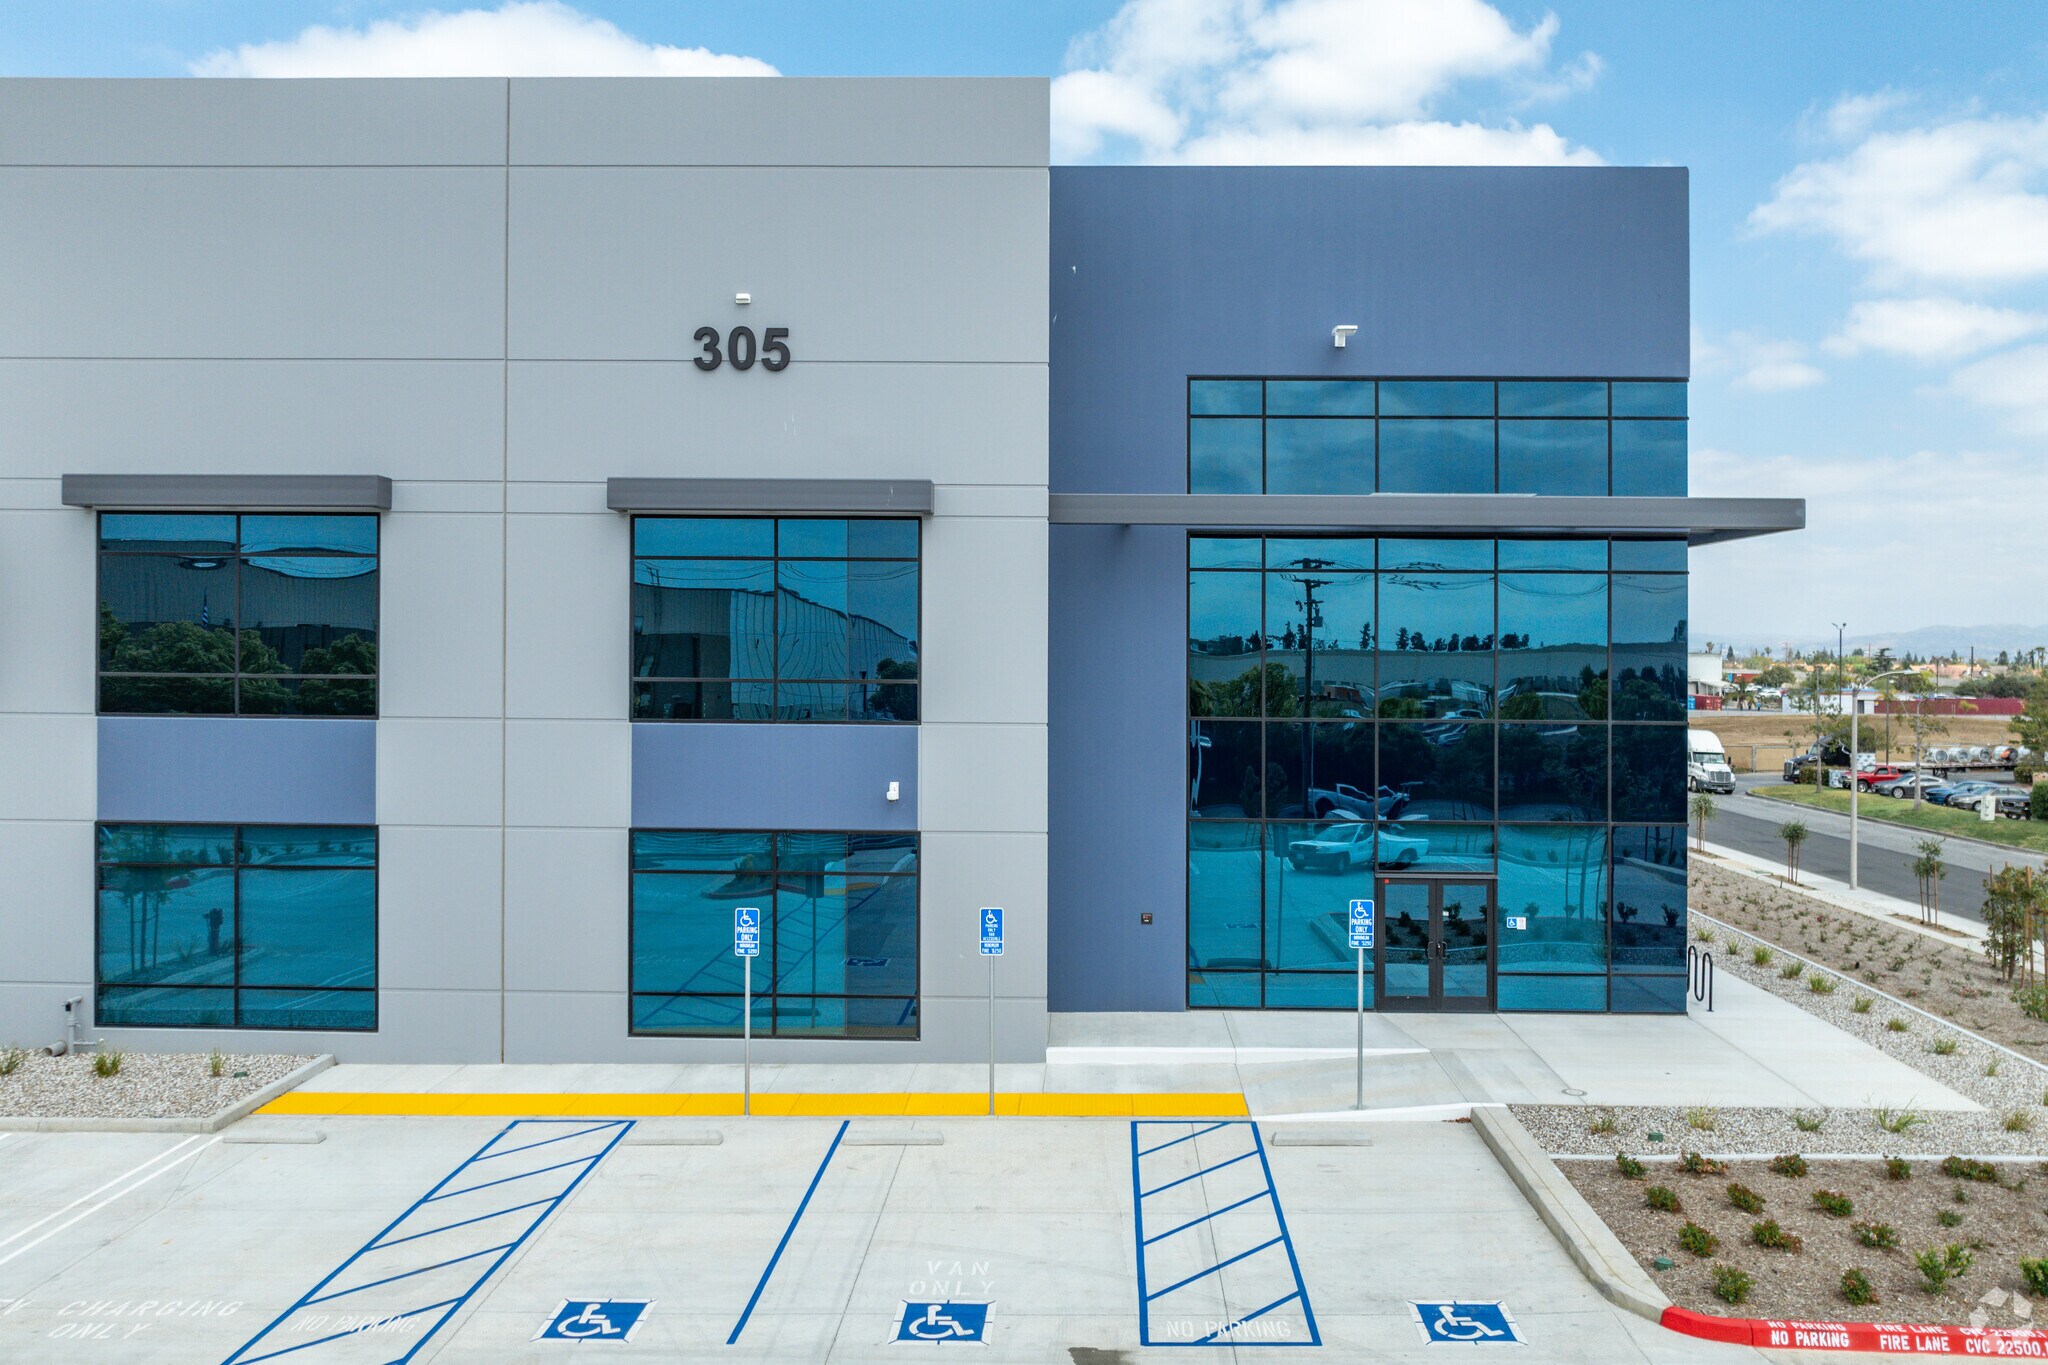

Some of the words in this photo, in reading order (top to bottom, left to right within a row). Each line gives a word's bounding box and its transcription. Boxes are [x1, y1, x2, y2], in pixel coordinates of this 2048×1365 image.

[693, 325, 791, 371] 305
[927, 1260, 990, 1276] VAN
[909, 1280, 996, 1297] ONLY
[57, 1299, 245, 1317] CHARGING
[47, 1322, 152, 1340] ONLY
[290, 1315, 329, 1332] NO
[1166, 1320, 1195, 1338] NO
[1204, 1320, 1291, 1338] PARKING
[1767, 1320, 1787, 1329] NO
[1790, 1321, 1847, 1331] PARKING
[1873, 1323, 1907, 1333] FIRE
[1909, 1325, 1948, 1334] LANE
[1959, 1327, 1987, 1336] CVC
[1771, 1329, 1789, 1346] NO
[1795, 1330, 1850, 1348] PARKING
[1880, 1334, 1911, 1350] FIRE
[1916, 1335, 1951, 1352] LANE
[1965, 1338, 1991, 1354] CVC
